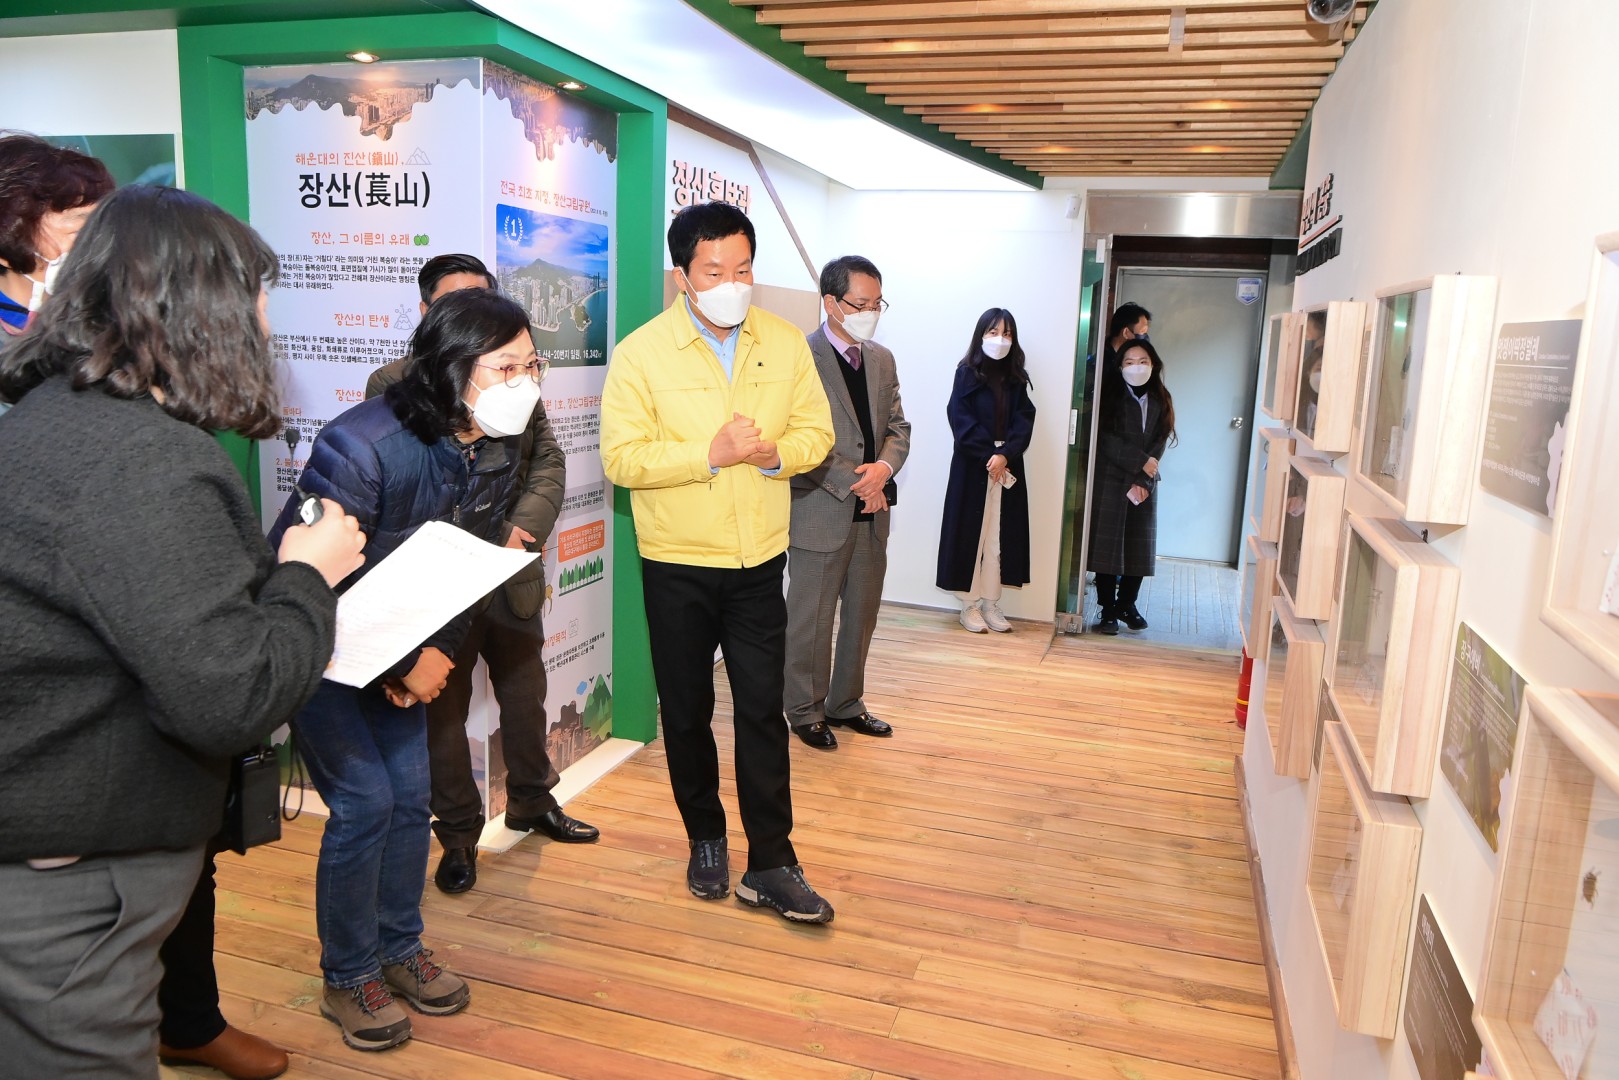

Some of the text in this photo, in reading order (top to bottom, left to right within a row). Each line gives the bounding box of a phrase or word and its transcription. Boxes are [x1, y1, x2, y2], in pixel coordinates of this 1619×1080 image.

[296, 152, 339, 166] 해운대의
[500, 180, 516, 198] 전국
[518, 185, 532, 200] 최초
[554, 193, 590, 214] 장산구립공원
[311, 232, 410, 246] 장산, 그 이름의 유래
[334, 313, 390, 328] 장산의 탄생
